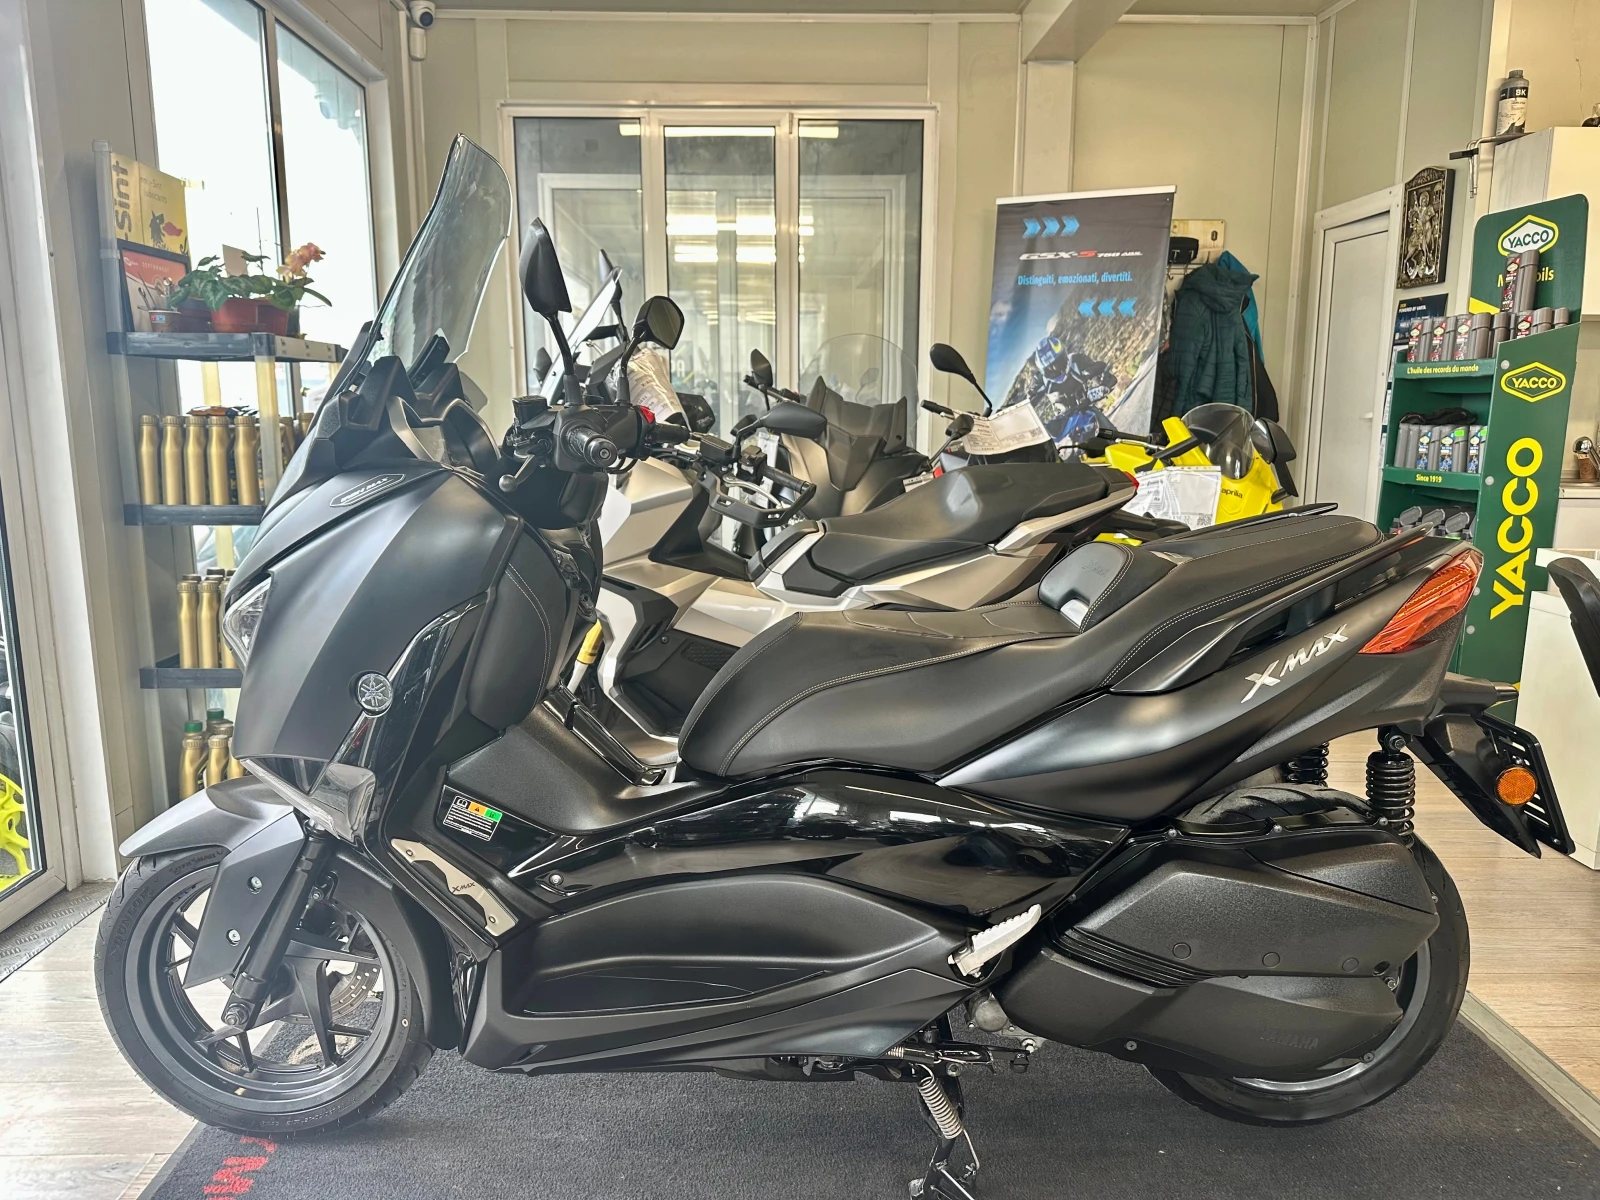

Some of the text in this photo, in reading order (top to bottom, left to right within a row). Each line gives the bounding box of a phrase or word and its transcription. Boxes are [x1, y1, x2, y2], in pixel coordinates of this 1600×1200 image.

[1515, 88, 1527, 96] BK
[1508, 229, 1550, 249] YACCO
[1017, 271, 1133, 286] Distinguiti, emozionati, divertiti.
[1407, 366, 1423, 374] L'huile
[1460, 364, 1479, 372] monde
[1511, 377, 1558, 389] YACCO
[1416, 473, 1443, 483] Since 1919
[1221, 488, 1243, 499] aprilia
[1489, 437, 1543, 620] YACCO
